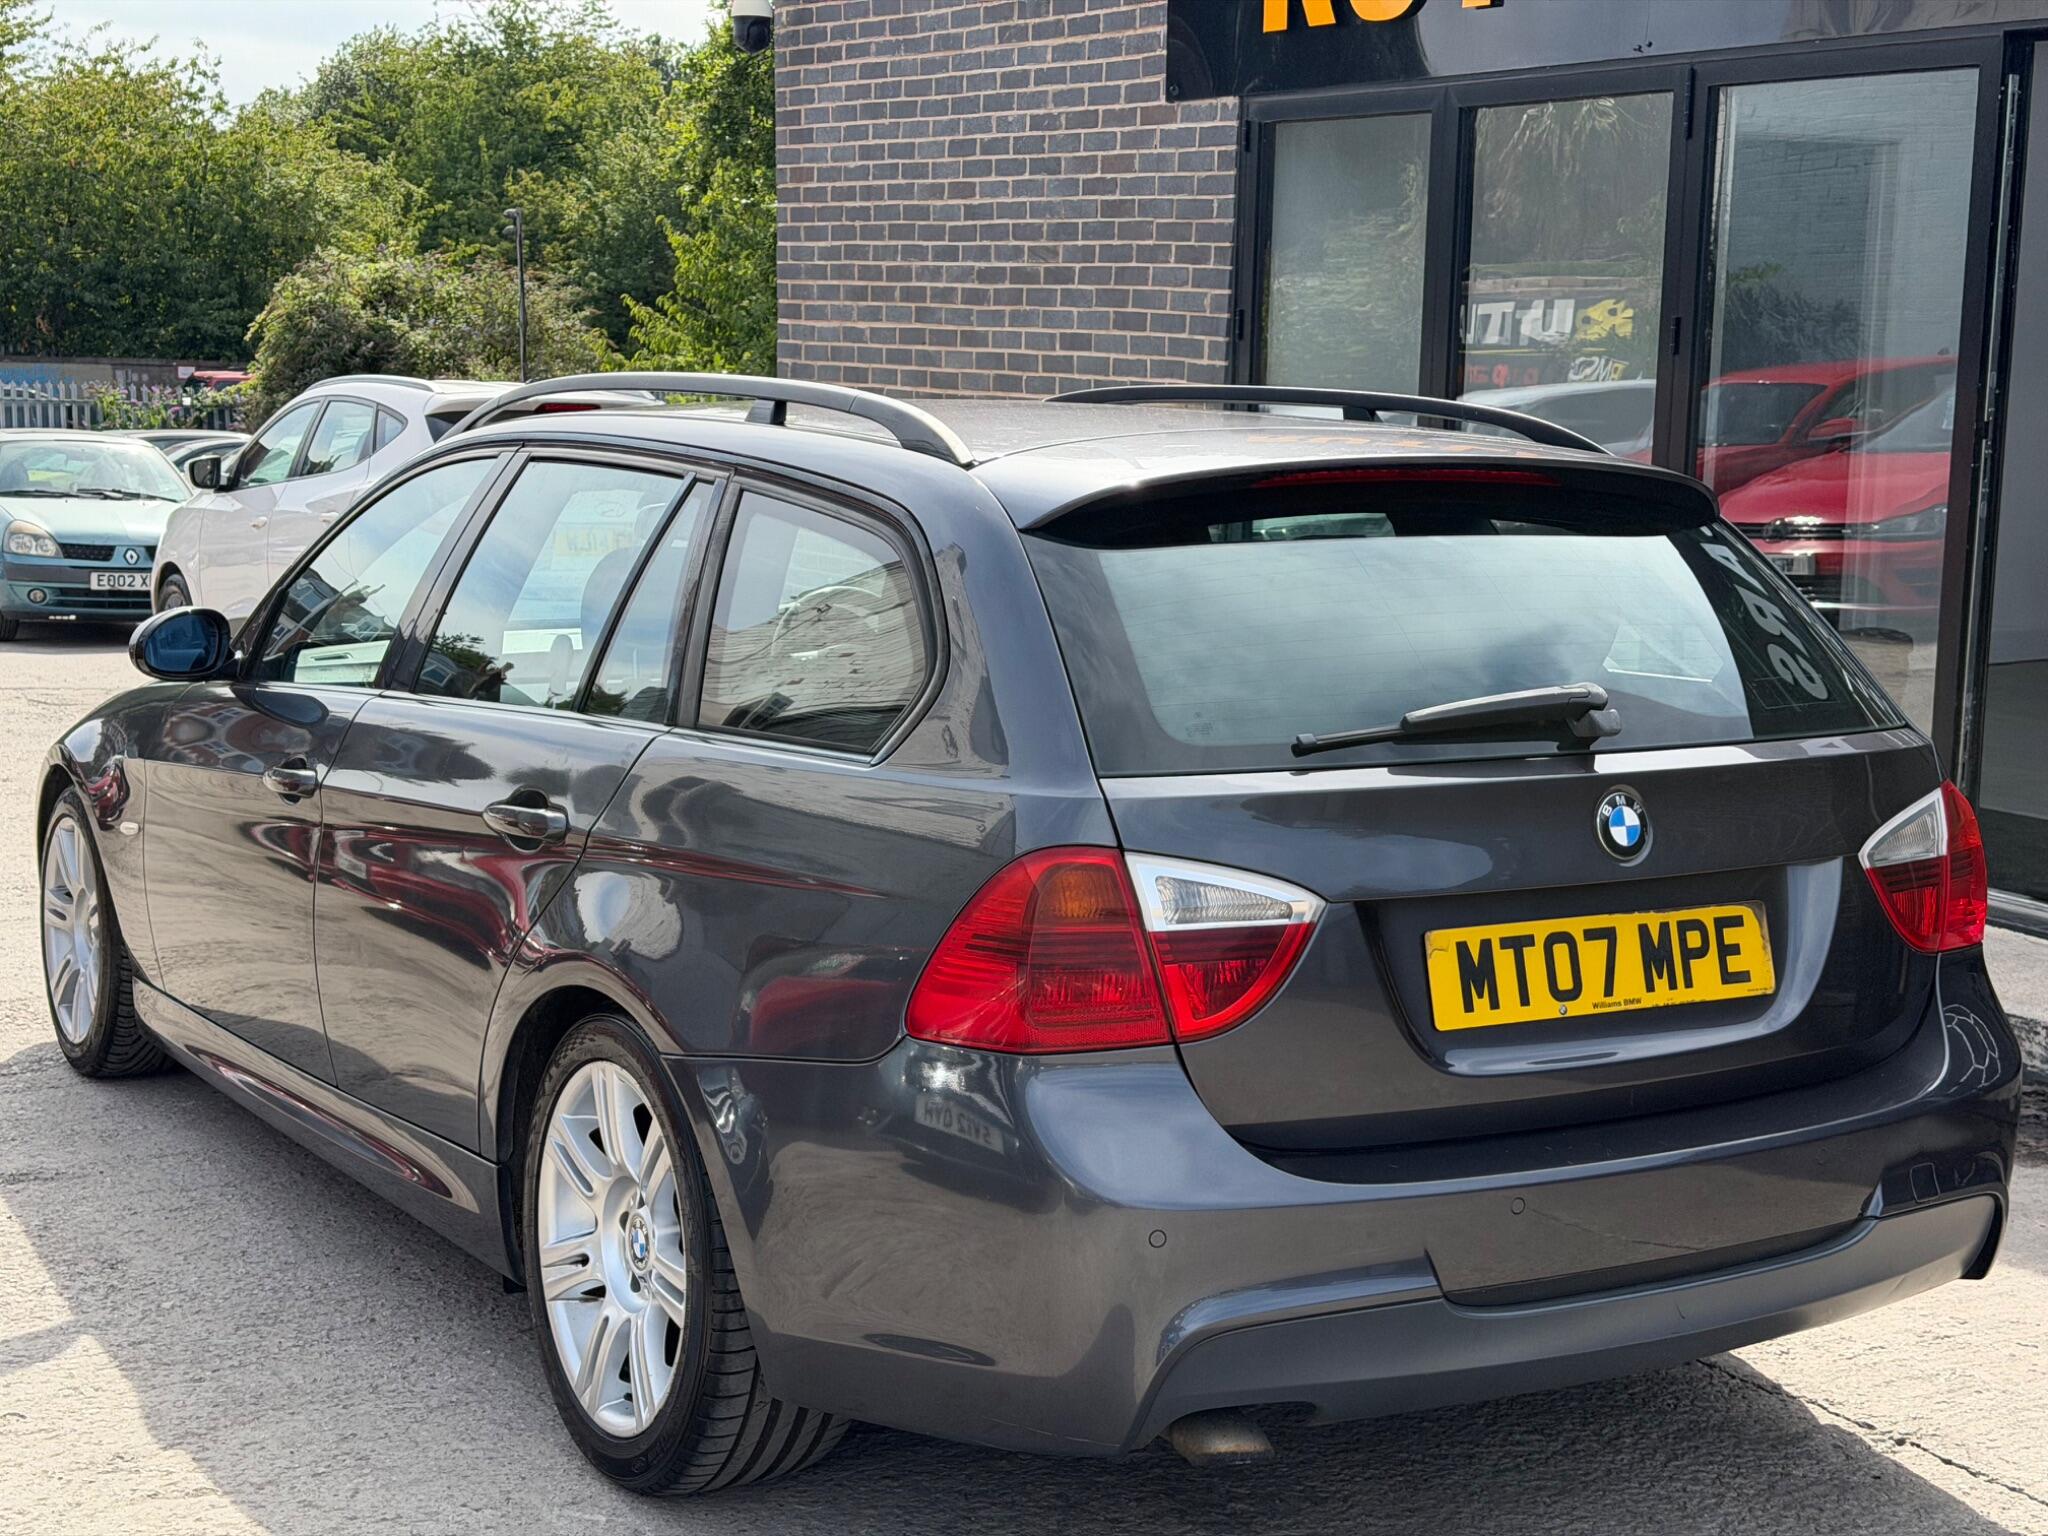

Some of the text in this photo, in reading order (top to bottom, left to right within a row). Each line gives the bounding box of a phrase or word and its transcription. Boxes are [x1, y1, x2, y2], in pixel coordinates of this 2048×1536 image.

[1602, 795, 1643, 817] BMW
[1455, 915, 1751, 1013] MT07 MPE
[1592, 1000, 1622, 1010] Williams
[1623, 998, 1642, 1006] BMW
